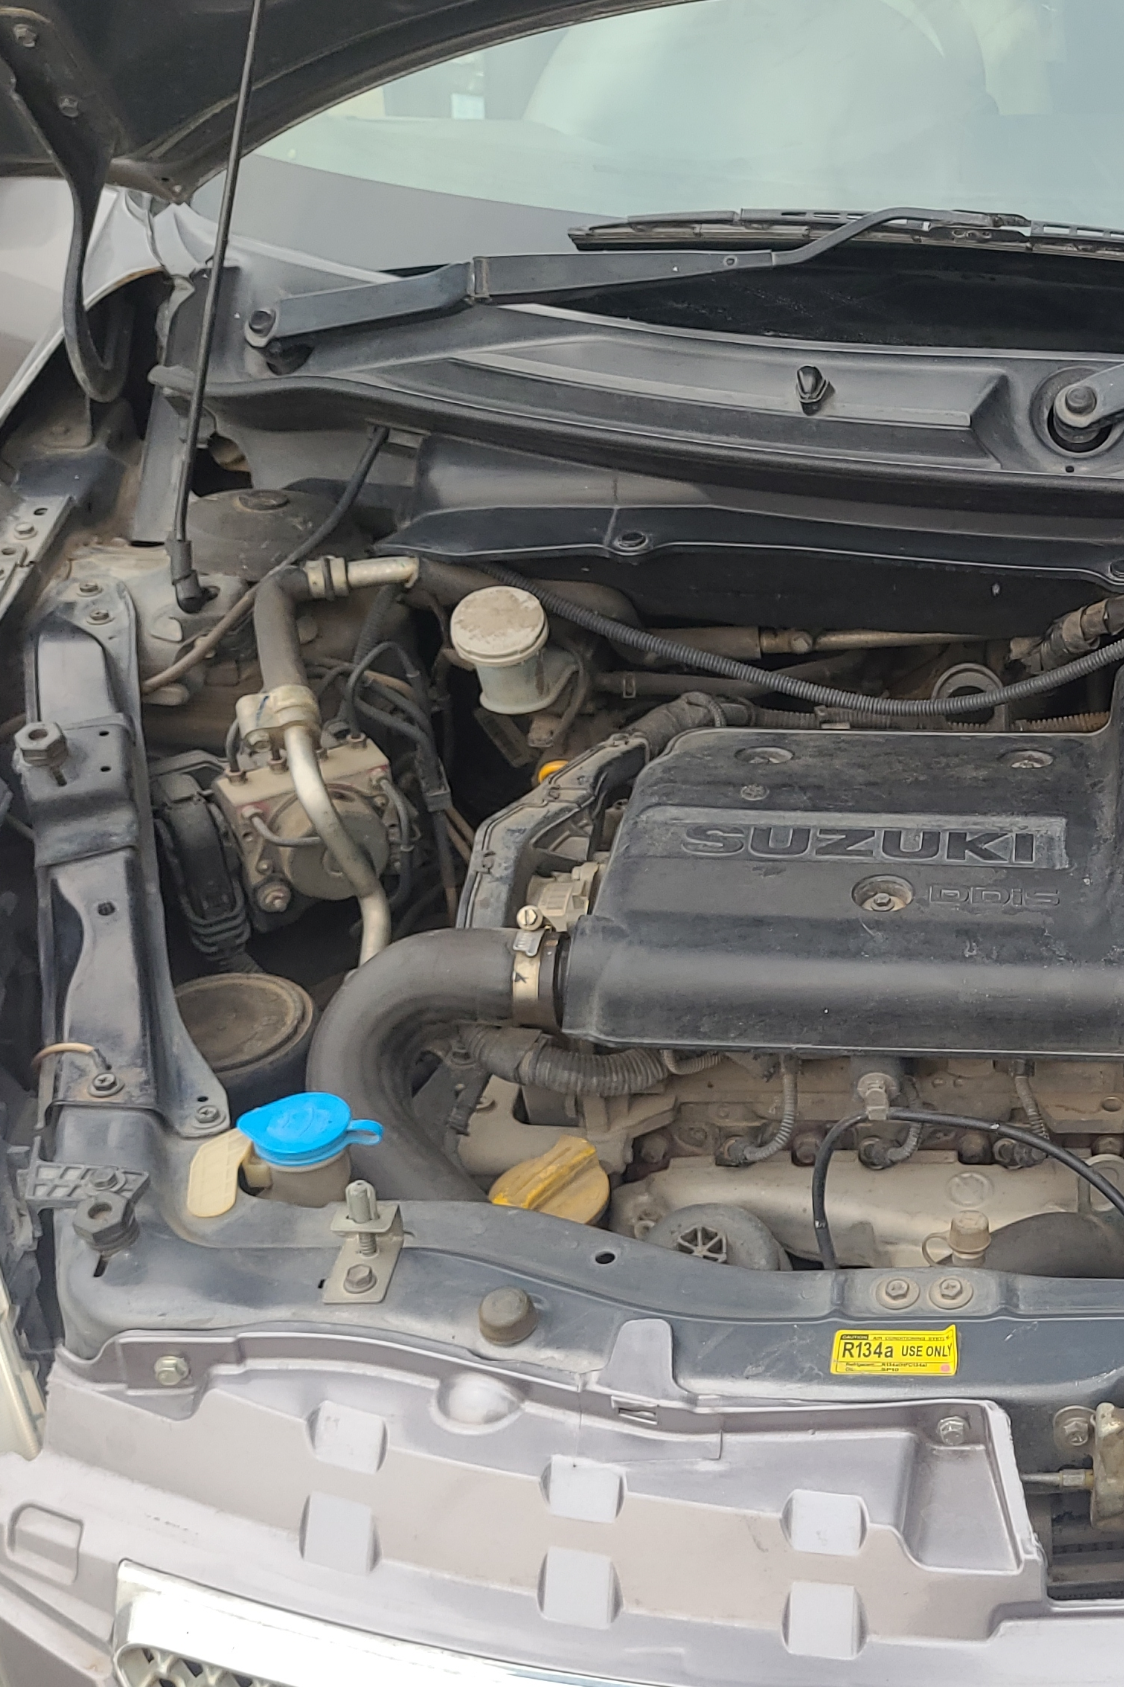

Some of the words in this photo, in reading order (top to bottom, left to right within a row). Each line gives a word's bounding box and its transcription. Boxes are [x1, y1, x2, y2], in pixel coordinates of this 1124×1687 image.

[682, 824, 1036, 863] SUZUKI
[842, 1342, 893, 1358] R134a
[901, 1345, 923, 1357] USE
[926, 1343, 952, 1357] ONLY
